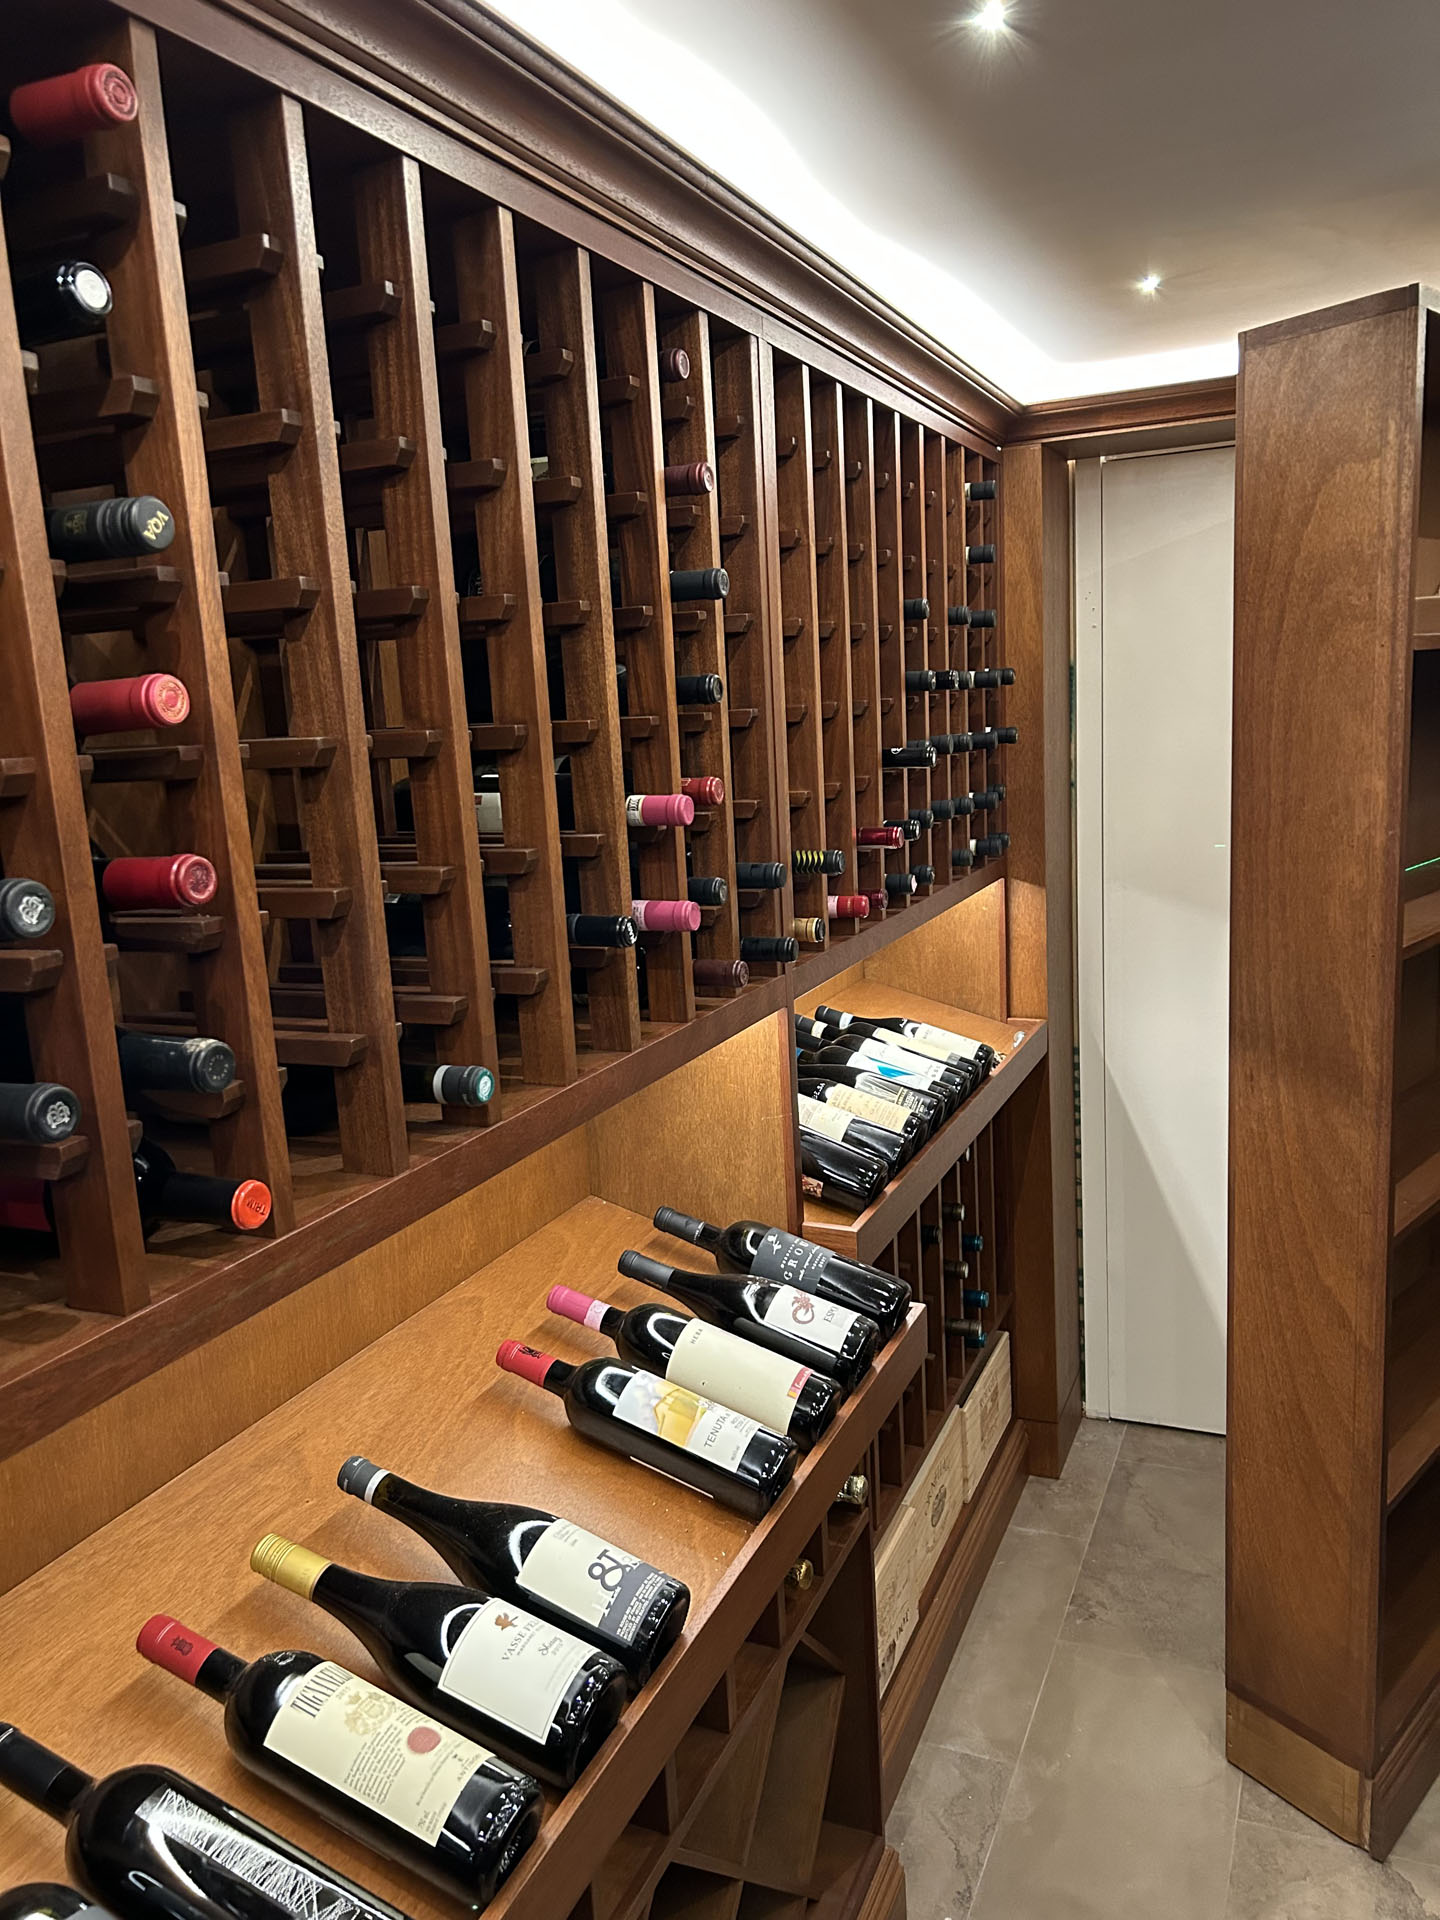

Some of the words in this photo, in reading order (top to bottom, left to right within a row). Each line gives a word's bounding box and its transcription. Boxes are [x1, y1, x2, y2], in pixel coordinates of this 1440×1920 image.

[142, 510, 169, 540] VQA
[703, 1414, 727, 1449] TENUTA
[501, 1629, 526, 1662] VASSE
